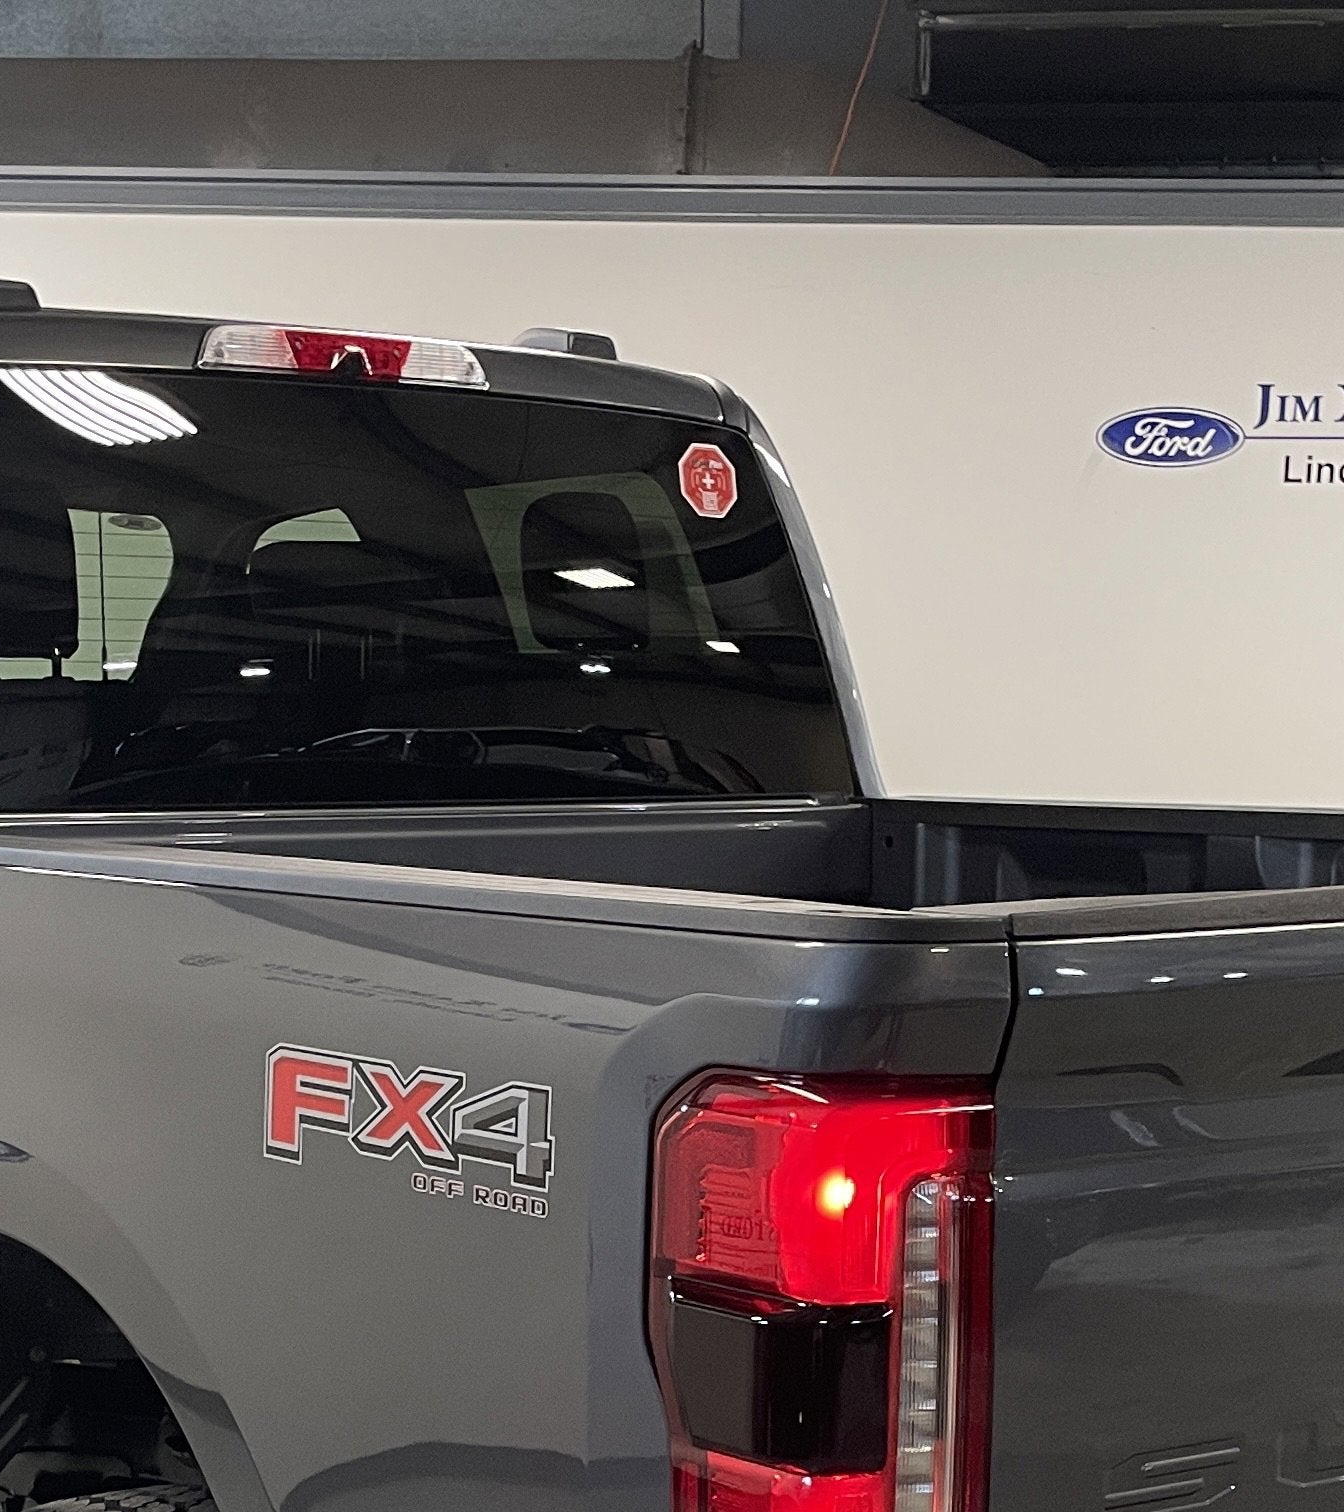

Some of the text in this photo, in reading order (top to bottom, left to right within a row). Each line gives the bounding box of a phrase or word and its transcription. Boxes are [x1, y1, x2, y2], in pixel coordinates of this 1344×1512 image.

[1124, 417, 1213, 458] Ford
[263, 1042, 555, 1193] FX4
[411, 1173, 549, 1218] OFF ROAD
